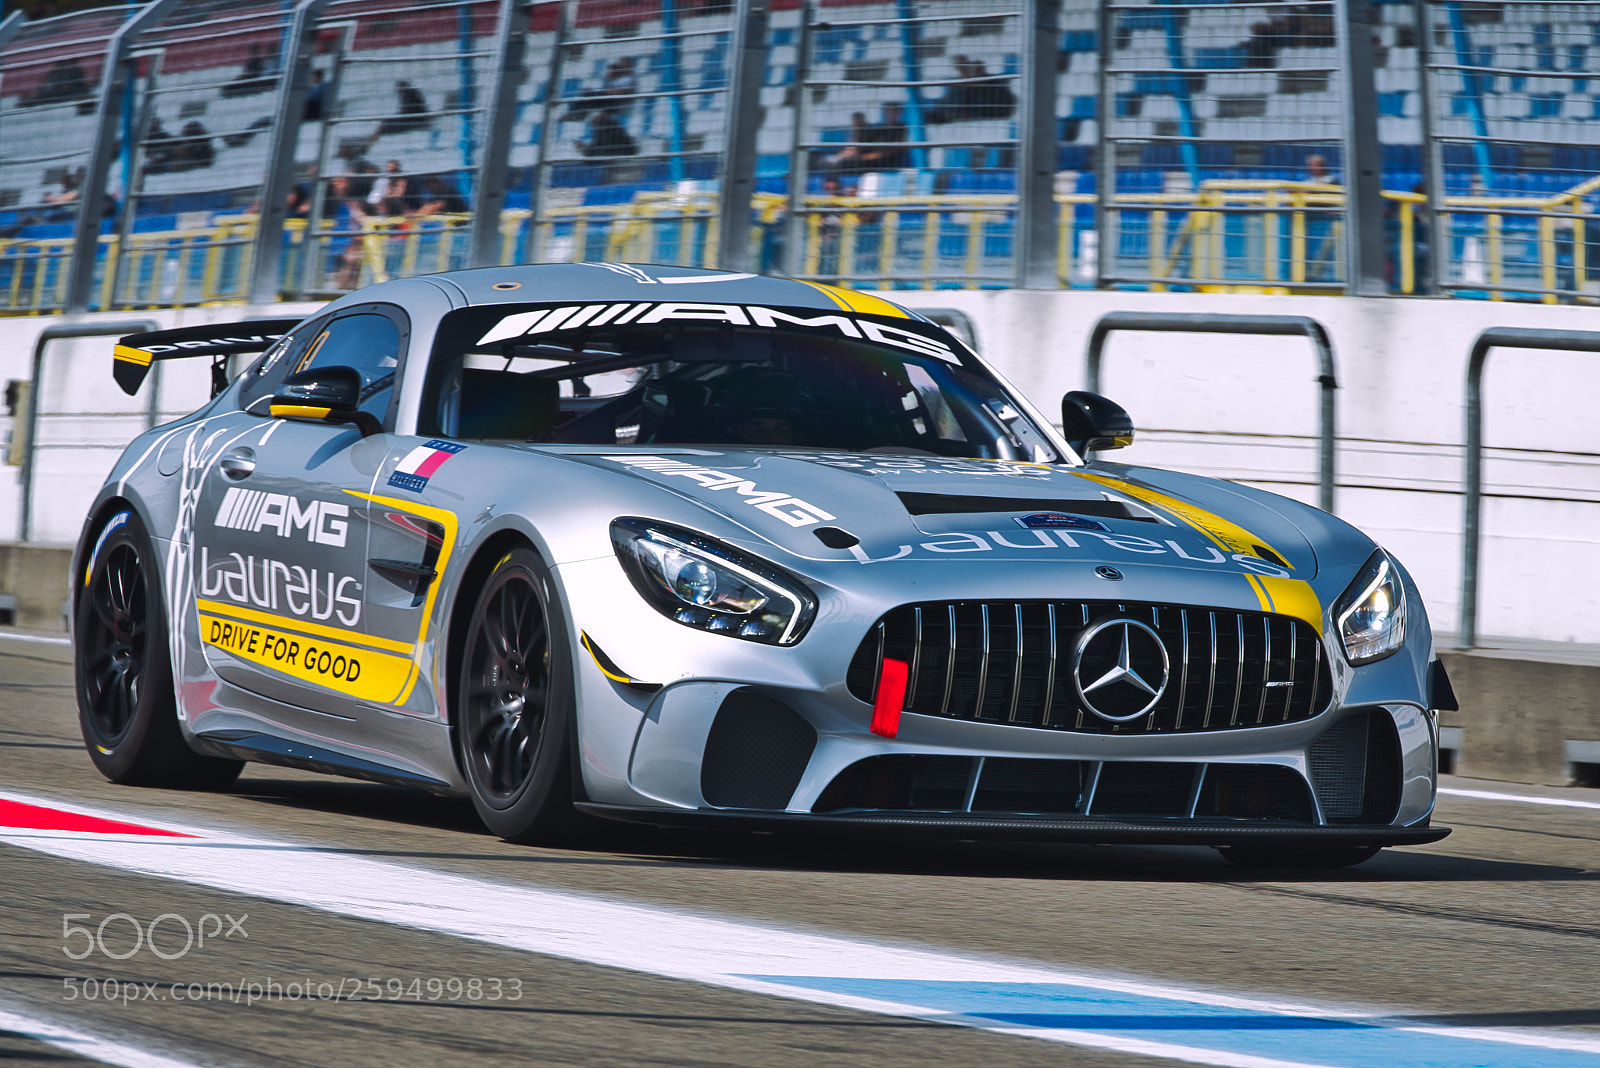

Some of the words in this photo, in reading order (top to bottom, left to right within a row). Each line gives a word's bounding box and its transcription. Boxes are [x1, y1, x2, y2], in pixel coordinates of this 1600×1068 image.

[637, 302, 963, 367] AMG
[254, 491, 350, 548] AMG
[688, 469, 837, 528] AMG
[210, 620, 260, 654] DRIVE
[262, 634, 299, 666] FOR
[304, 646, 362, 682] GOOD
